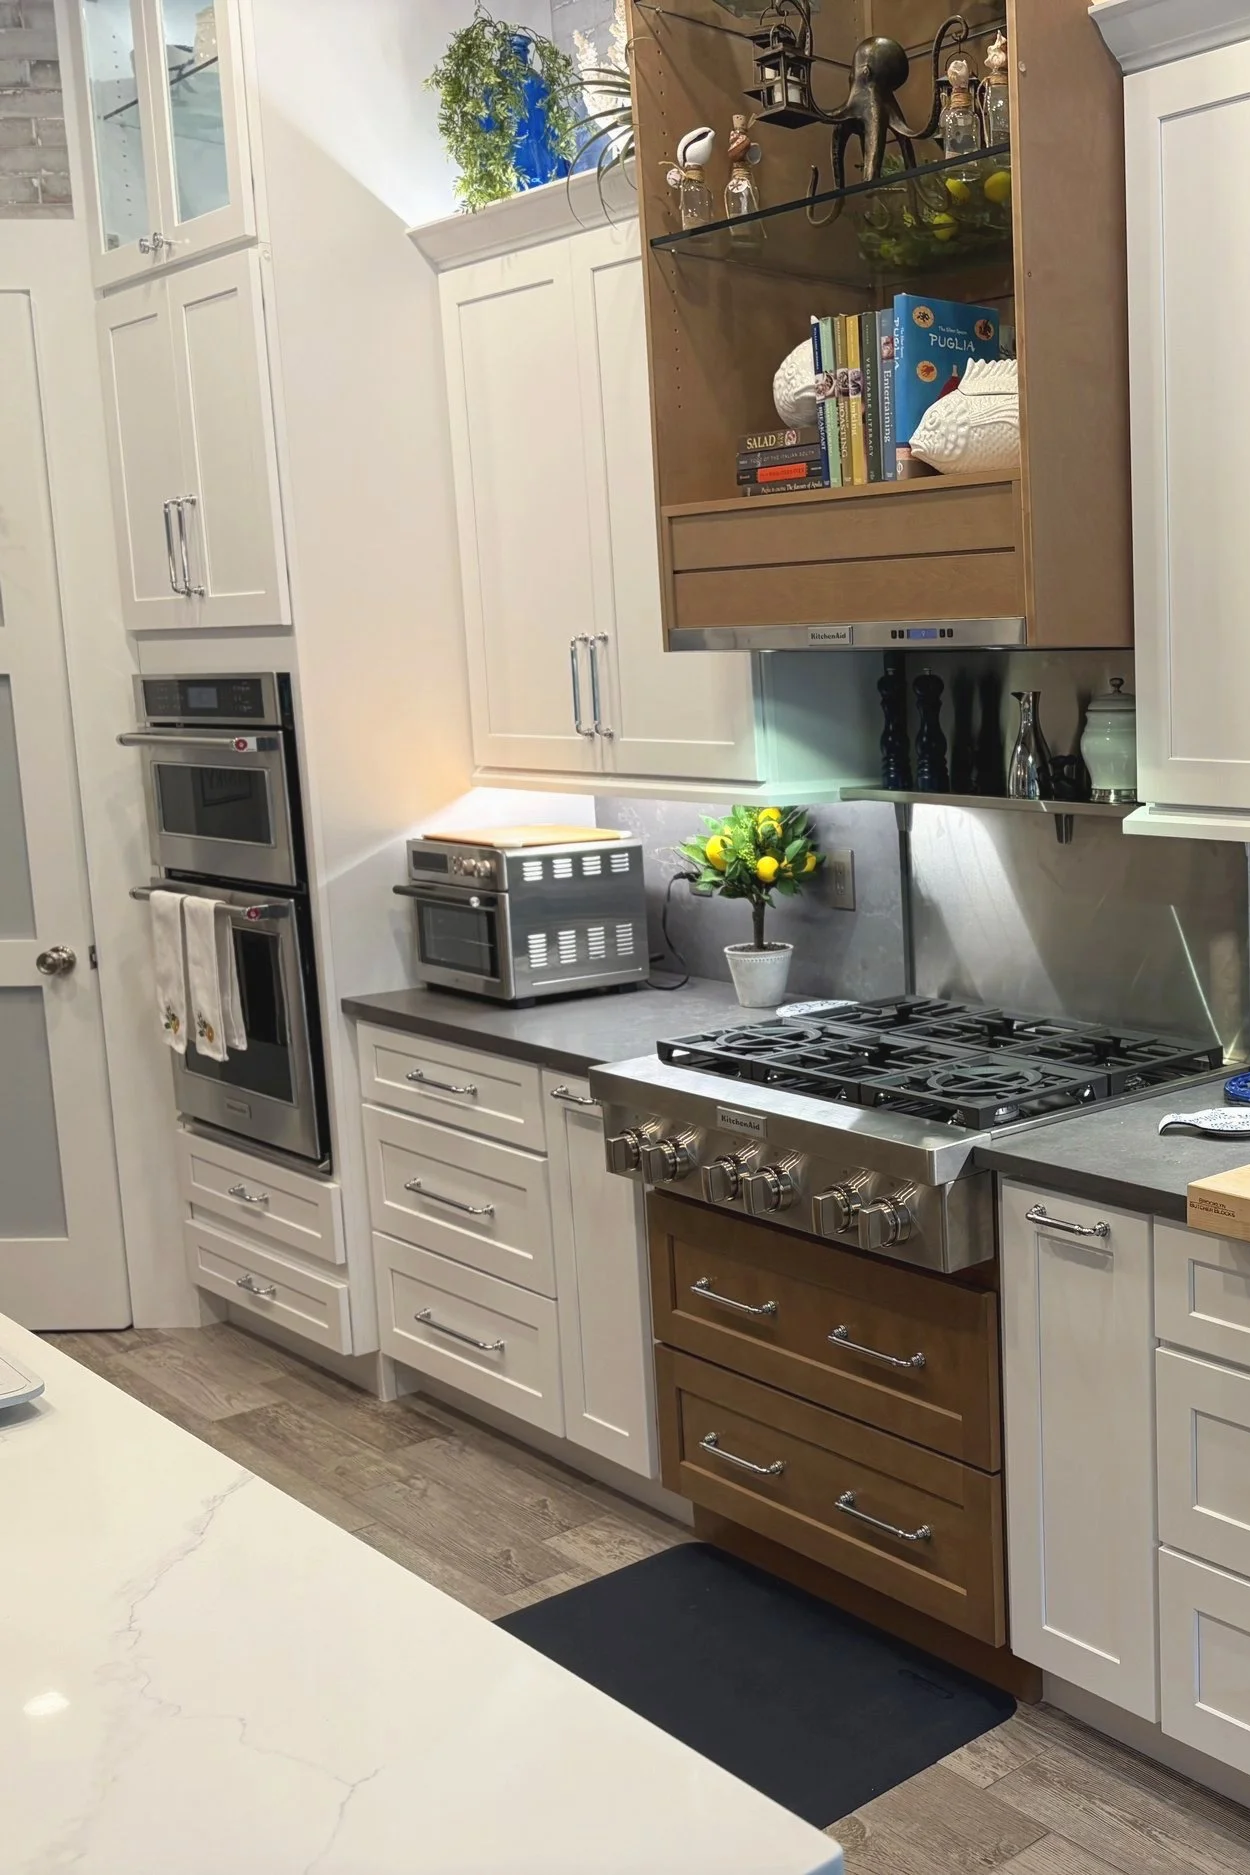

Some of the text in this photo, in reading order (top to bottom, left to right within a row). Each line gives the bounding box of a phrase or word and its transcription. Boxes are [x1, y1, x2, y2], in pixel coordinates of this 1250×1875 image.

[928, 333, 976, 353] PUGLIA
[850, 401, 858, 437] baking
[883, 370, 893, 443] Entertaining
[746, 434, 776, 450] SALAD
[818, 406, 826, 450] BREAKFAST
[839, 402, 848, 458] ROASTING
[810, 632, 847, 640] KitchenAid
[721, 1114, 760, 1131] KitchenAid
